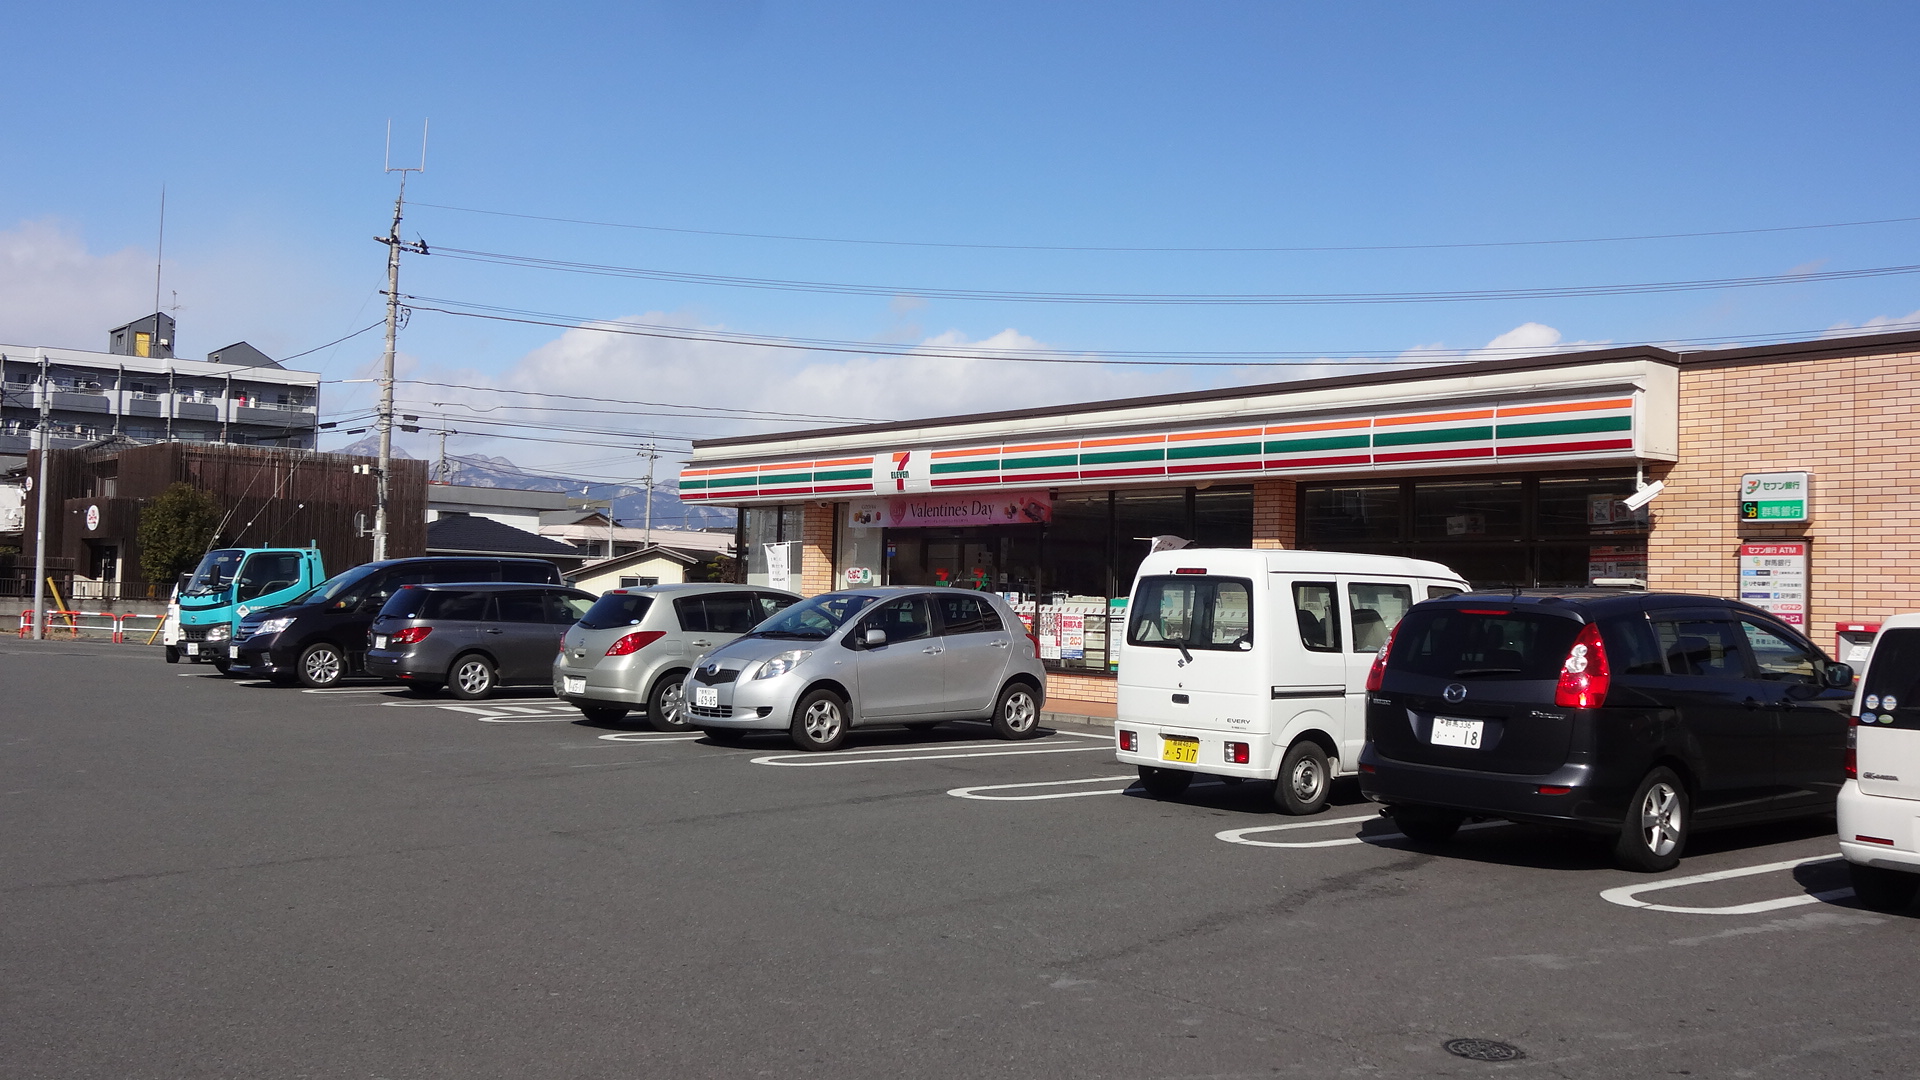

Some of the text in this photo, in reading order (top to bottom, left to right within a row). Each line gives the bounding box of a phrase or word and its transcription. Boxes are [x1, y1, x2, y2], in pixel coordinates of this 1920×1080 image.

[892, 451, 911, 490] 7
[1763, 481, 1800, 490] セブン銀行
[910, 500, 995, 521] Valentine's Day
[1762, 506, 1801, 517] 群馬銀行
